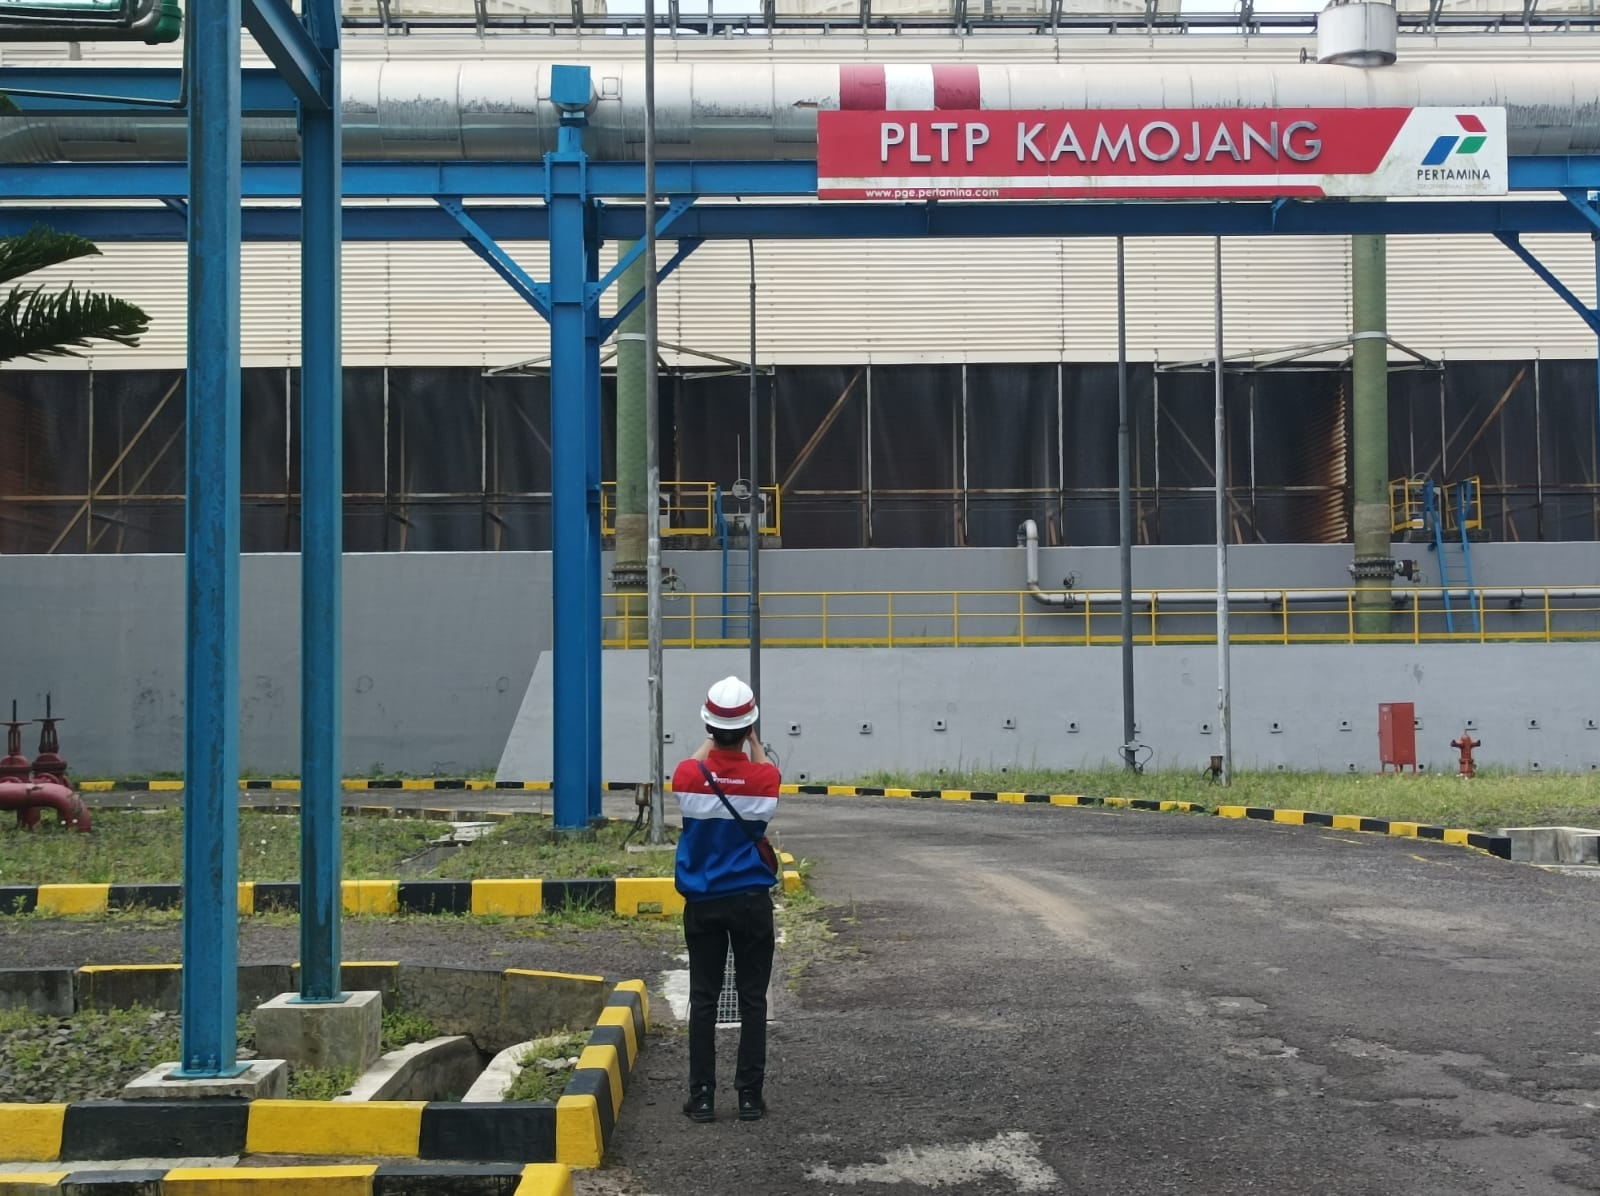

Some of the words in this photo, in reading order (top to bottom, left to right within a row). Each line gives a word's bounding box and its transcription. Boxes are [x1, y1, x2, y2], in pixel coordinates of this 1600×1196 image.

[880, 122, 990, 163] PLTP
[1016, 121, 1323, 163] KAMOJANG
[1417, 169, 1490, 180] PERTAMINA
[865, 188, 999, 199] www.pge.pertamina.com
